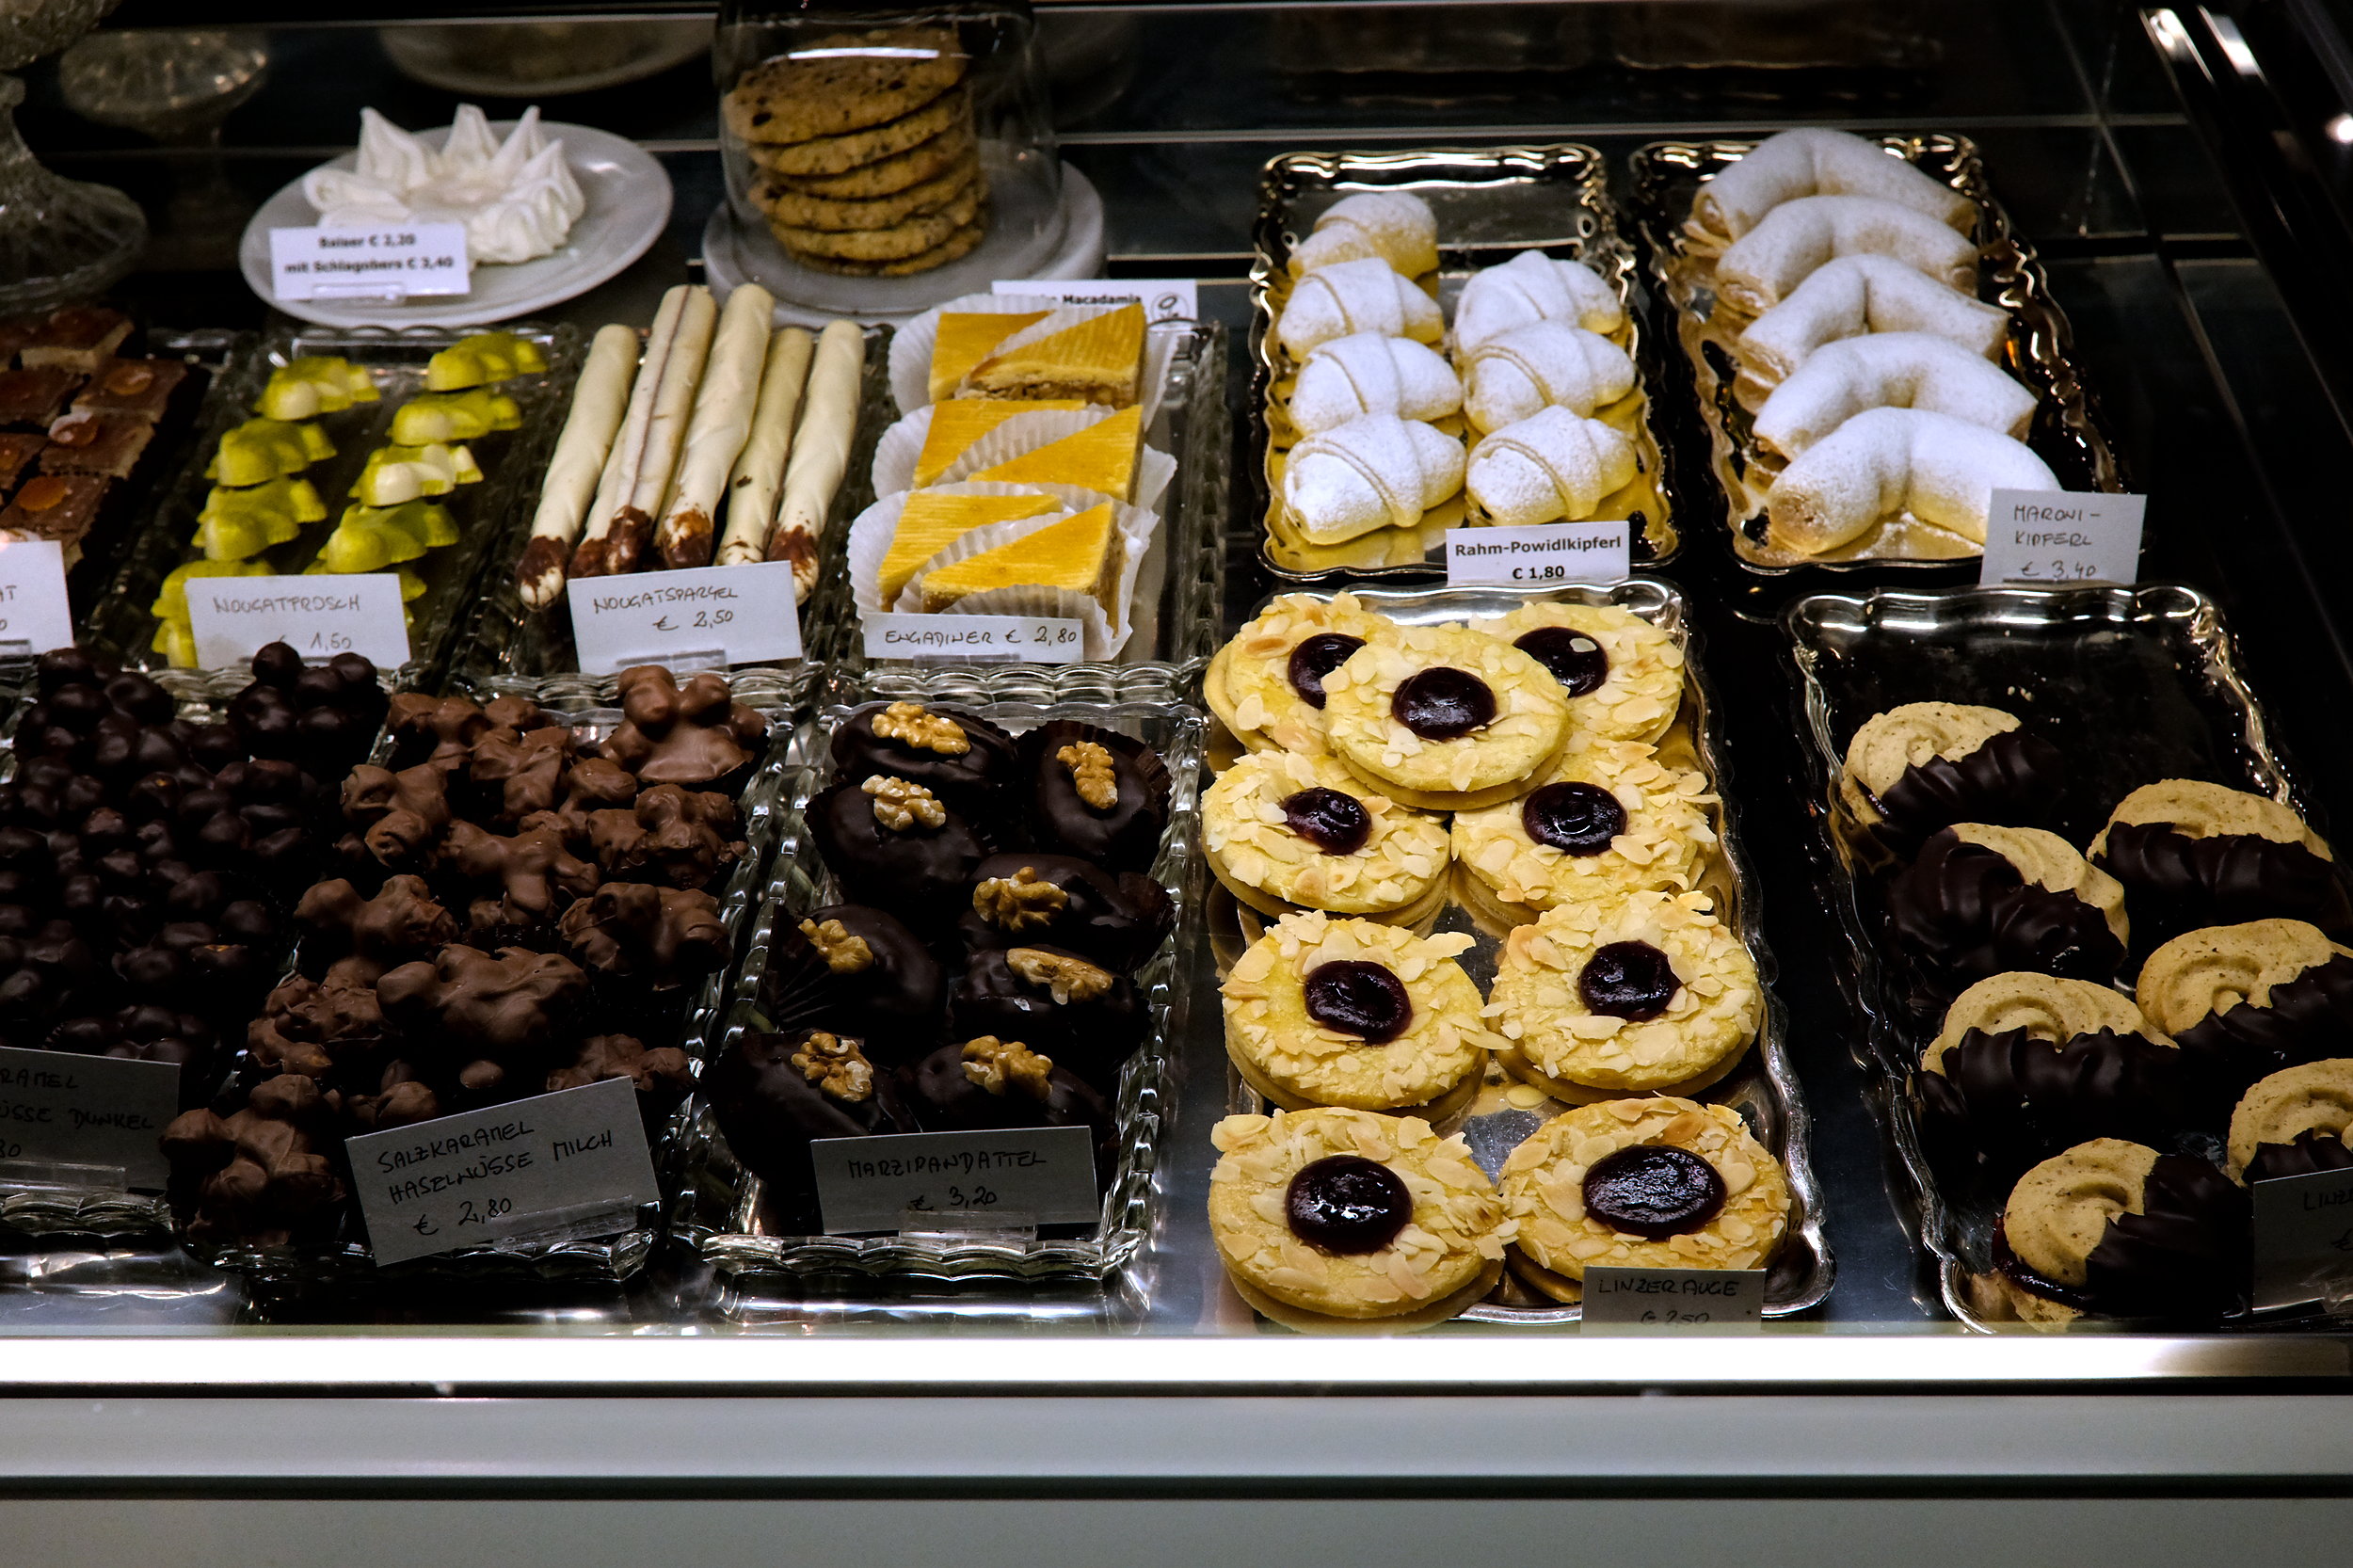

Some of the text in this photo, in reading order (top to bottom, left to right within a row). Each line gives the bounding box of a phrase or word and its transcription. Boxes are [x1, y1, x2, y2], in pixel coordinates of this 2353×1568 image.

[284, 262, 309, 274] mit
[313, 258, 403, 274] Schlagobers
[1455, 536, 1621, 556] Rahm-Powidlkipferl
[1513, 566, 1564, 581] € 1,80
[2021, 560, 2097, 580] € 3,40
[652, 609, 734, 631] € 2,50
[885, 625, 1077, 648] ENGADINER € 2,80
[68, 1108, 154, 1130] DUNKEL
[377, 1121, 535, 1174] SALZKARAMEL
[389, 1129, 613, 1205] HASELNÜSSE MILCH
[848, 1151, 1047, 1178] MARZIPANDATTEL
[908, 1186, 998, 1211] € 3,20
[413, 1197, 511, 1236] € 2,80
